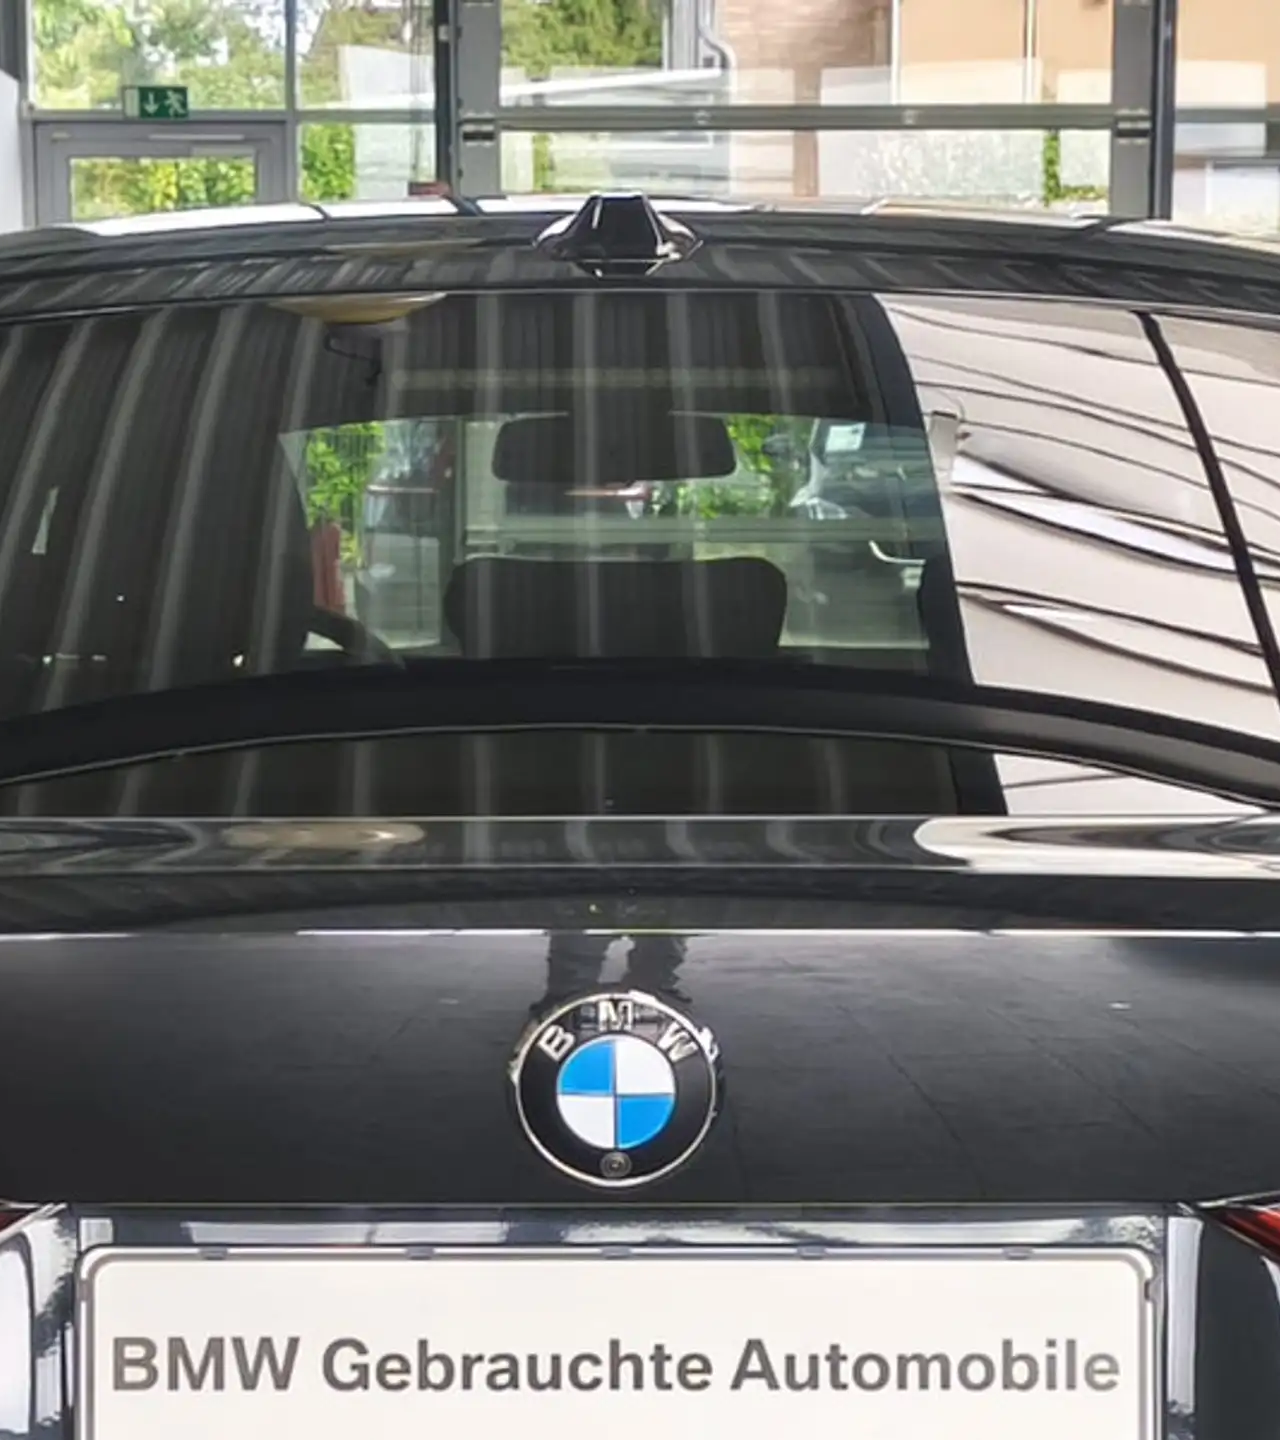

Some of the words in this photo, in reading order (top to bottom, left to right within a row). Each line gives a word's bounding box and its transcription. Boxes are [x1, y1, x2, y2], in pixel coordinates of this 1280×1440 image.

[537, 1000, 699, 1063] BMW
[112, 1336, 301, 1391] BMW
[322, 1338, 713, 1392] Gebrauchte
[730, 1338, 1120, 1391] Automobile
